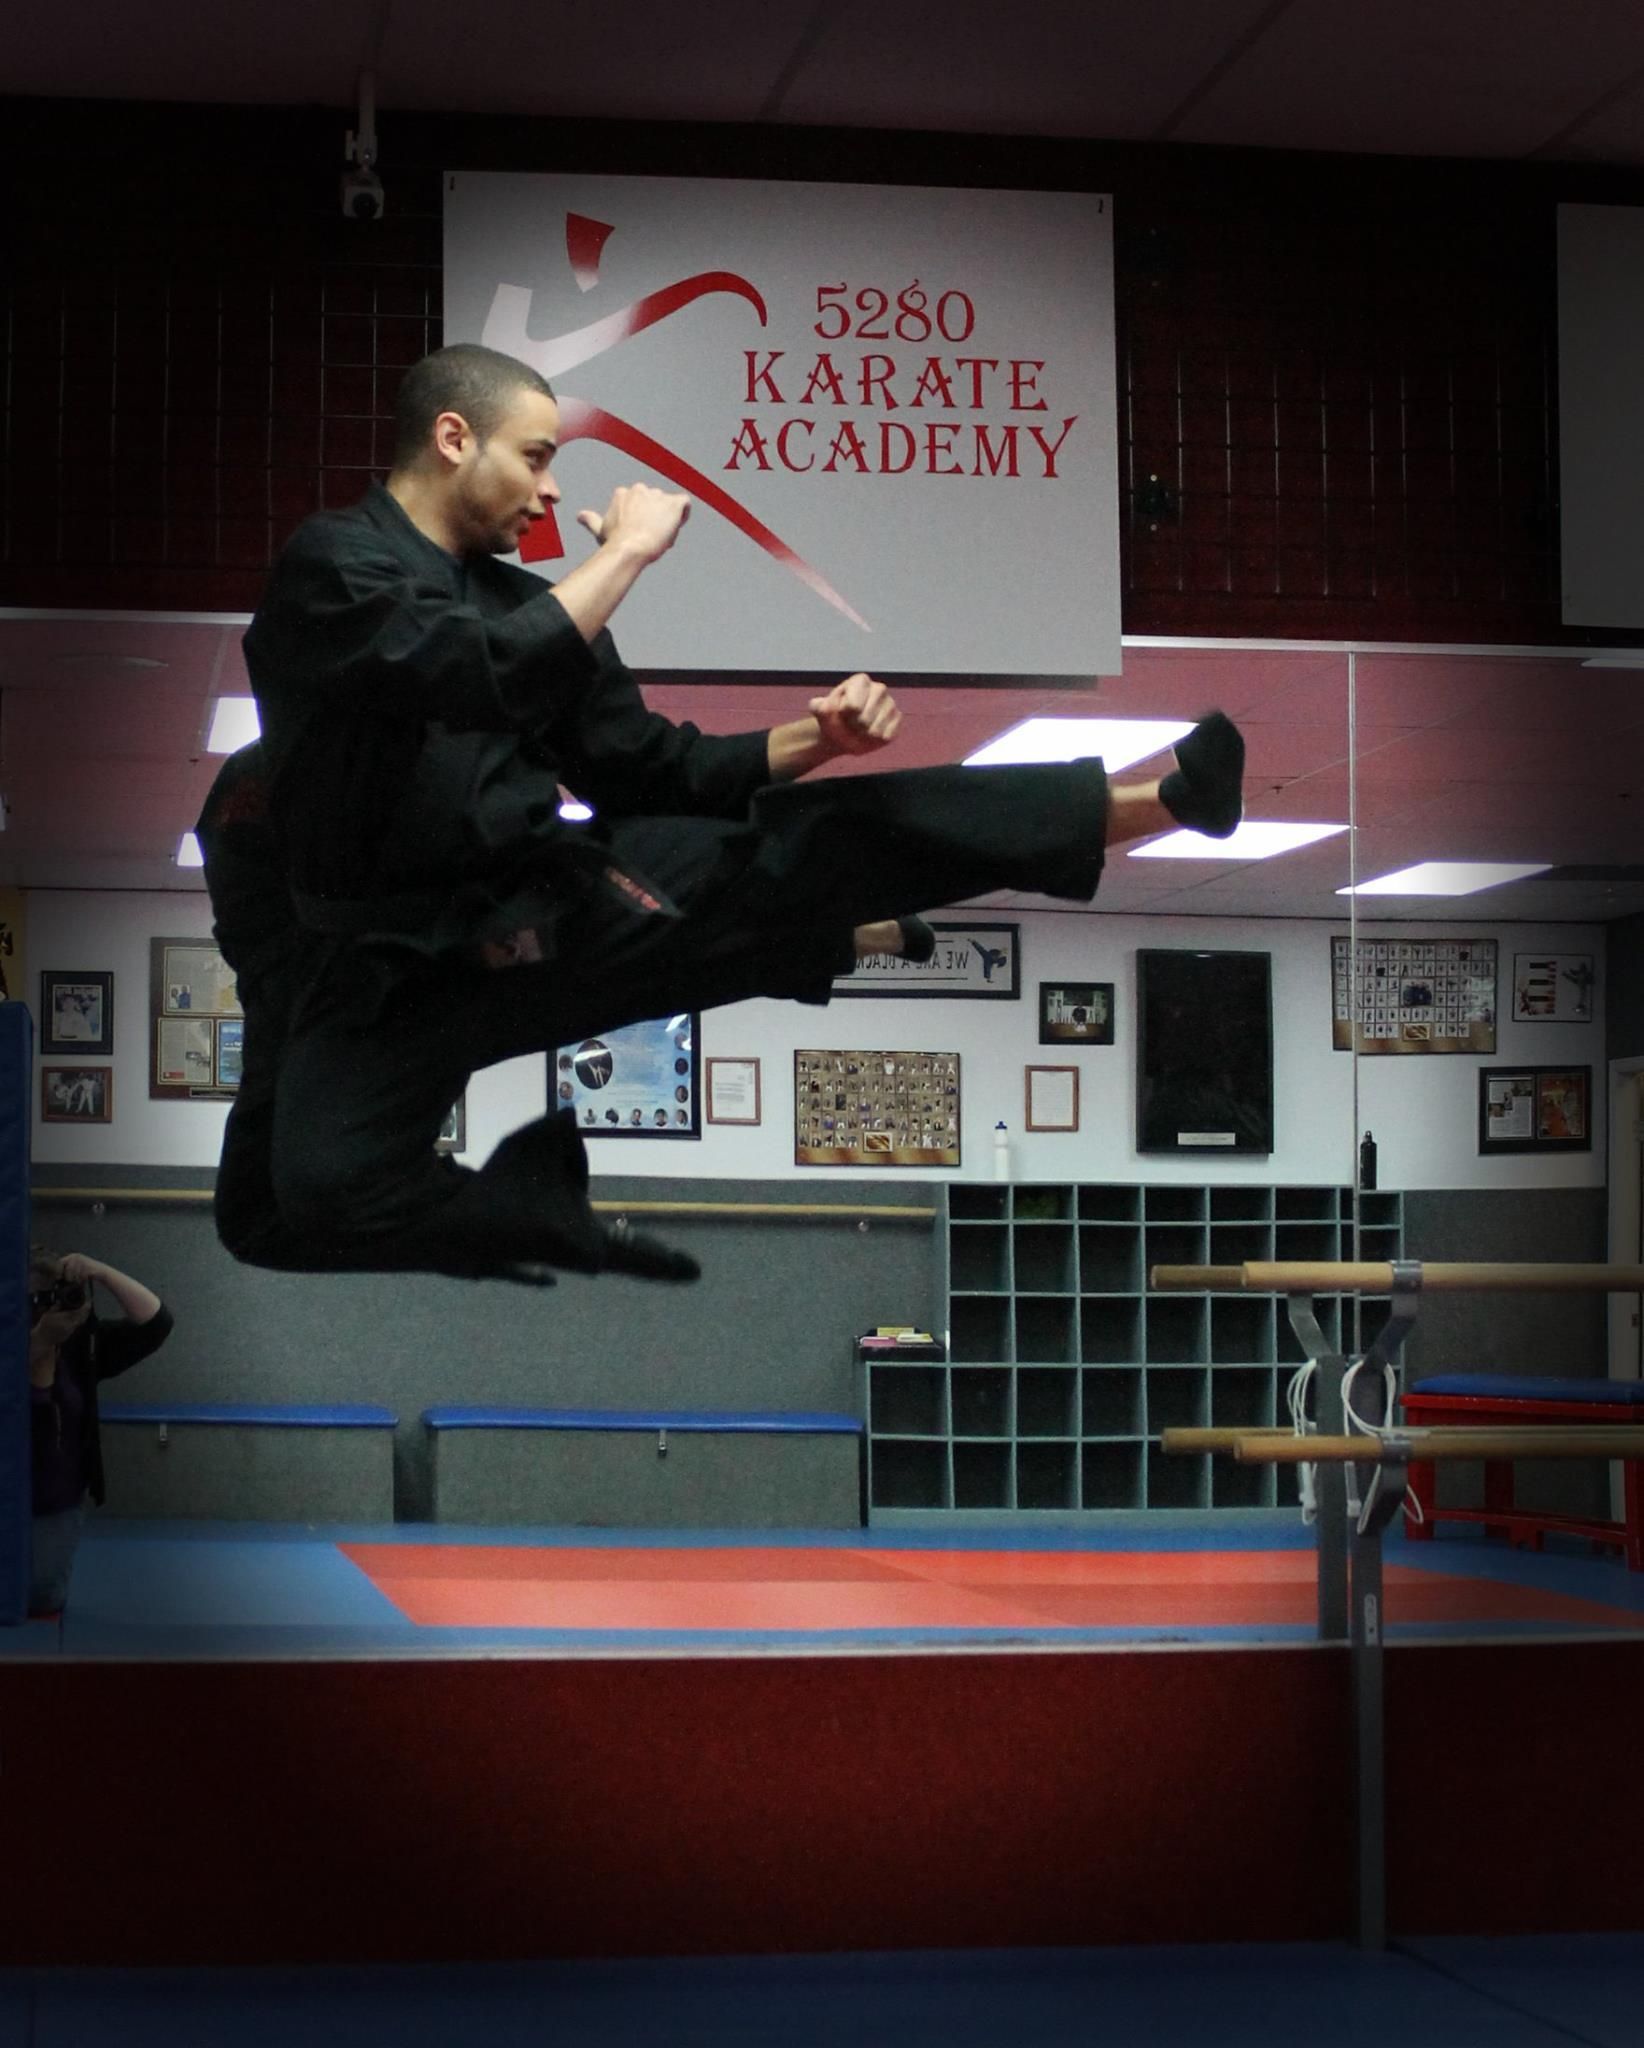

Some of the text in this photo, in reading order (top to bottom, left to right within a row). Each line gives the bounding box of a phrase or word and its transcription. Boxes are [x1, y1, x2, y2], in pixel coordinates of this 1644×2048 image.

[814, 279, 976, 342] 5280
[744, 351, 1048, 411] KARATE
[723, 415, 1079, 478] ACADEMY
